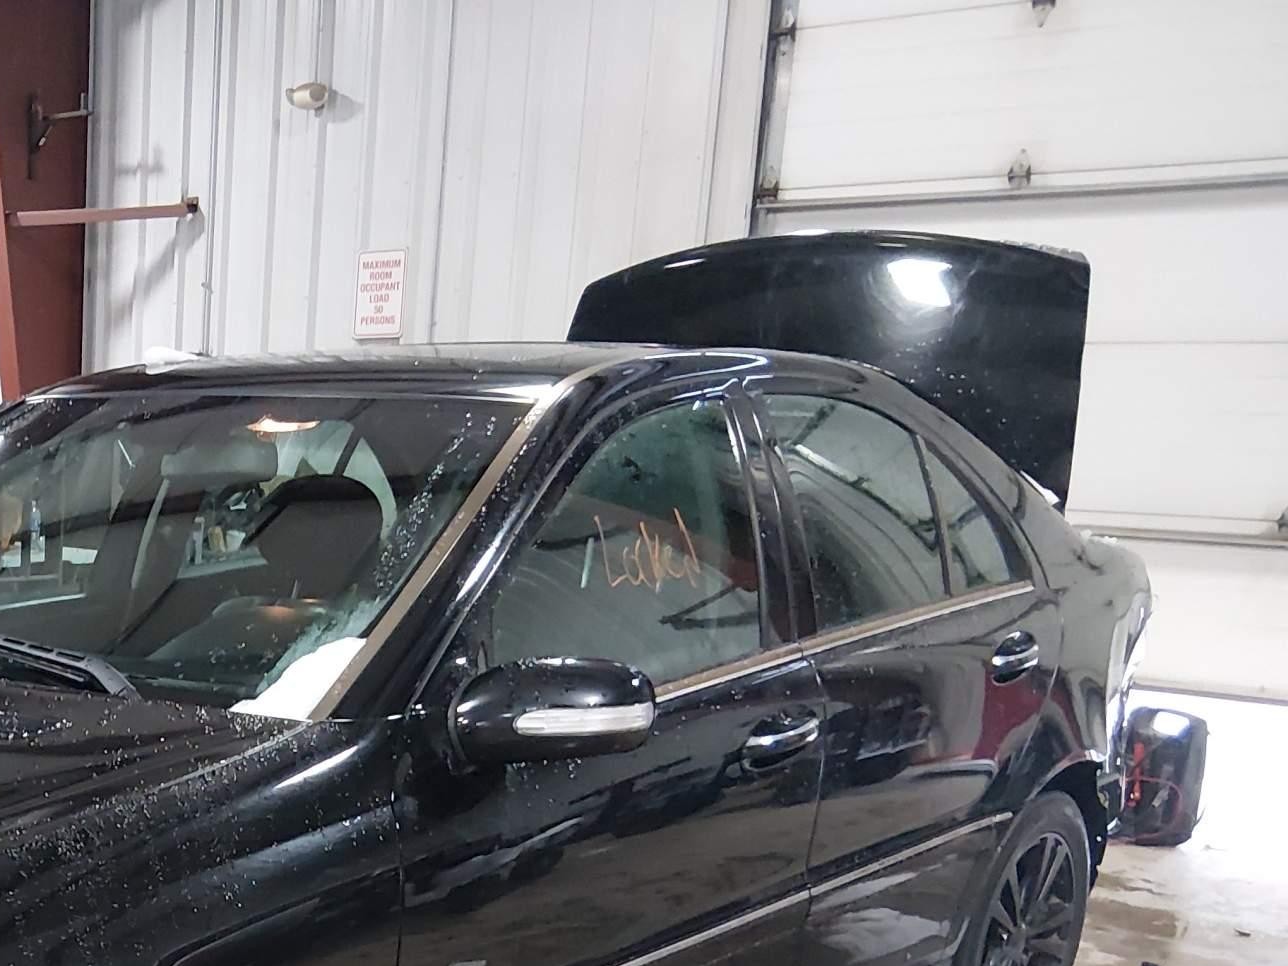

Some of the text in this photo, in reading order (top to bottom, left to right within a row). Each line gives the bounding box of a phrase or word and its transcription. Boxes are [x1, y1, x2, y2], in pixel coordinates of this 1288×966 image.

[362, 259, 402, 270] MAXIMUM
[369, 271, 393, 280] ROOM
[360, 281, 400, 293] OCCUPANT
[368, 293, 390, 304] LOAD
[360, 315, 396, 326] PERSONS
